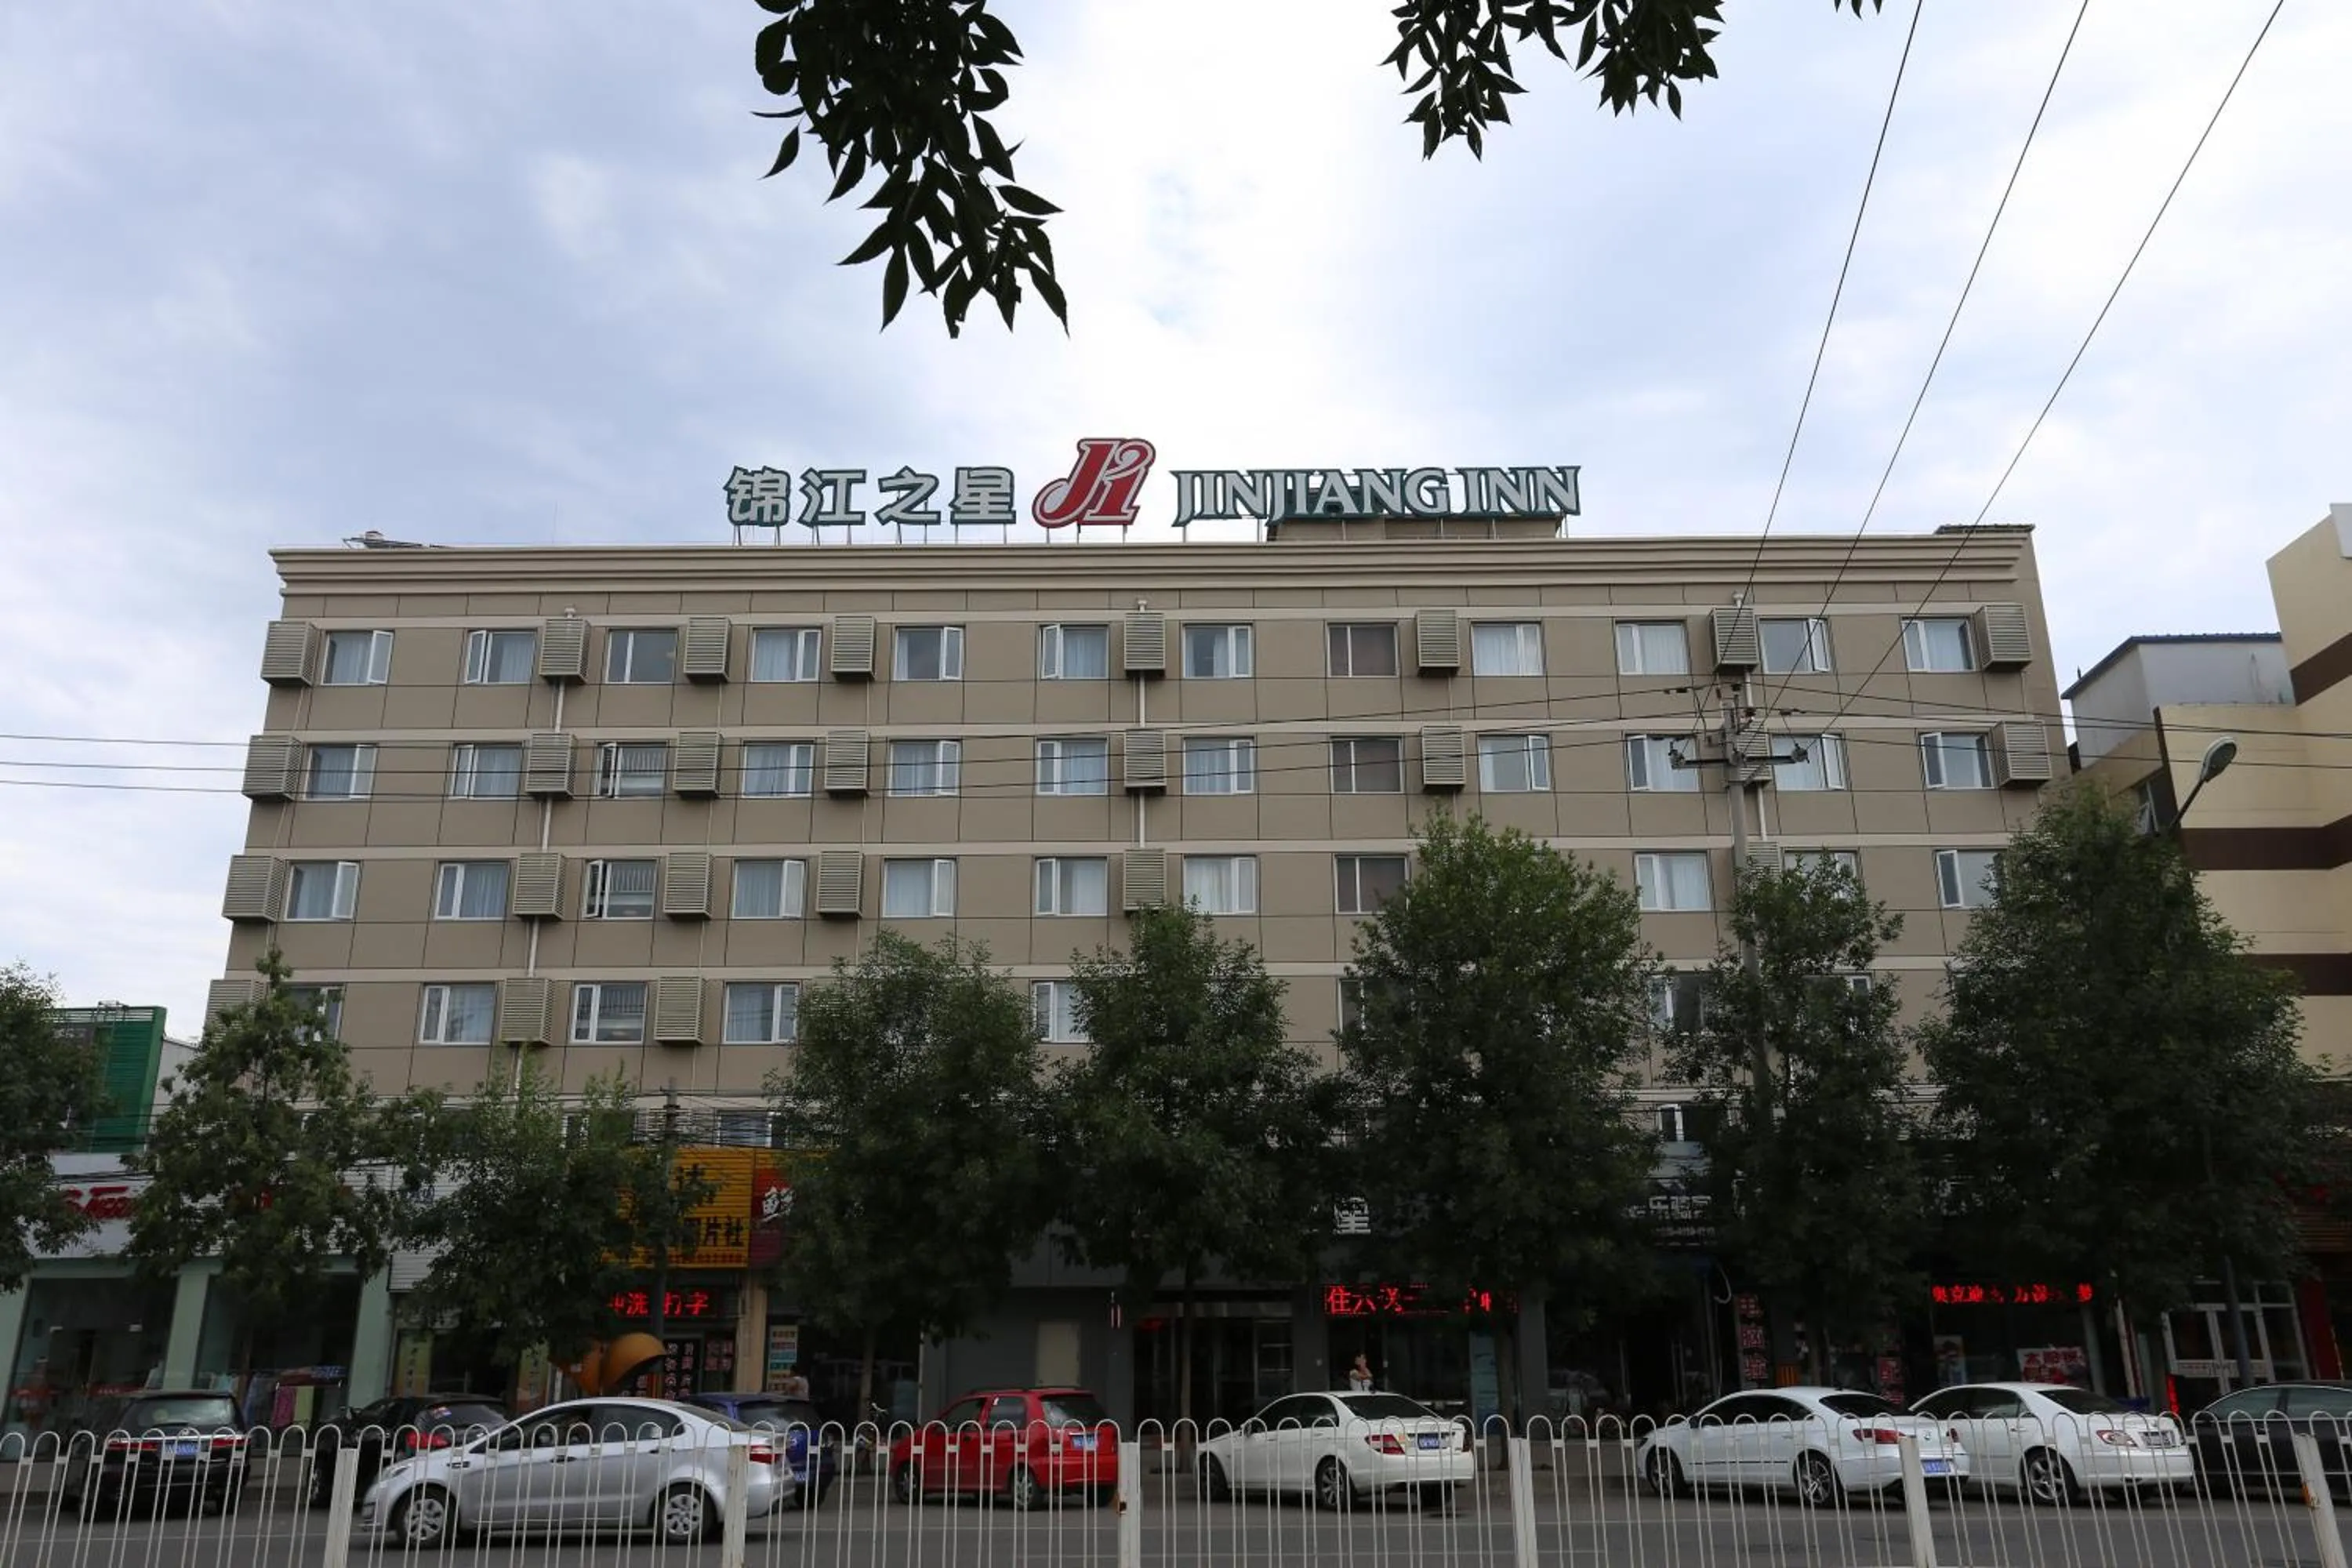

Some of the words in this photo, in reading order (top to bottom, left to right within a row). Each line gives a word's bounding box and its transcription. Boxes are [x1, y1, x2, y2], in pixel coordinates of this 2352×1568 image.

[723, 466, 1017, 527] 锦江之星
[1169, 467, 1452, 527] JINJIANG
[1455, 466, 1581, 517] INN
